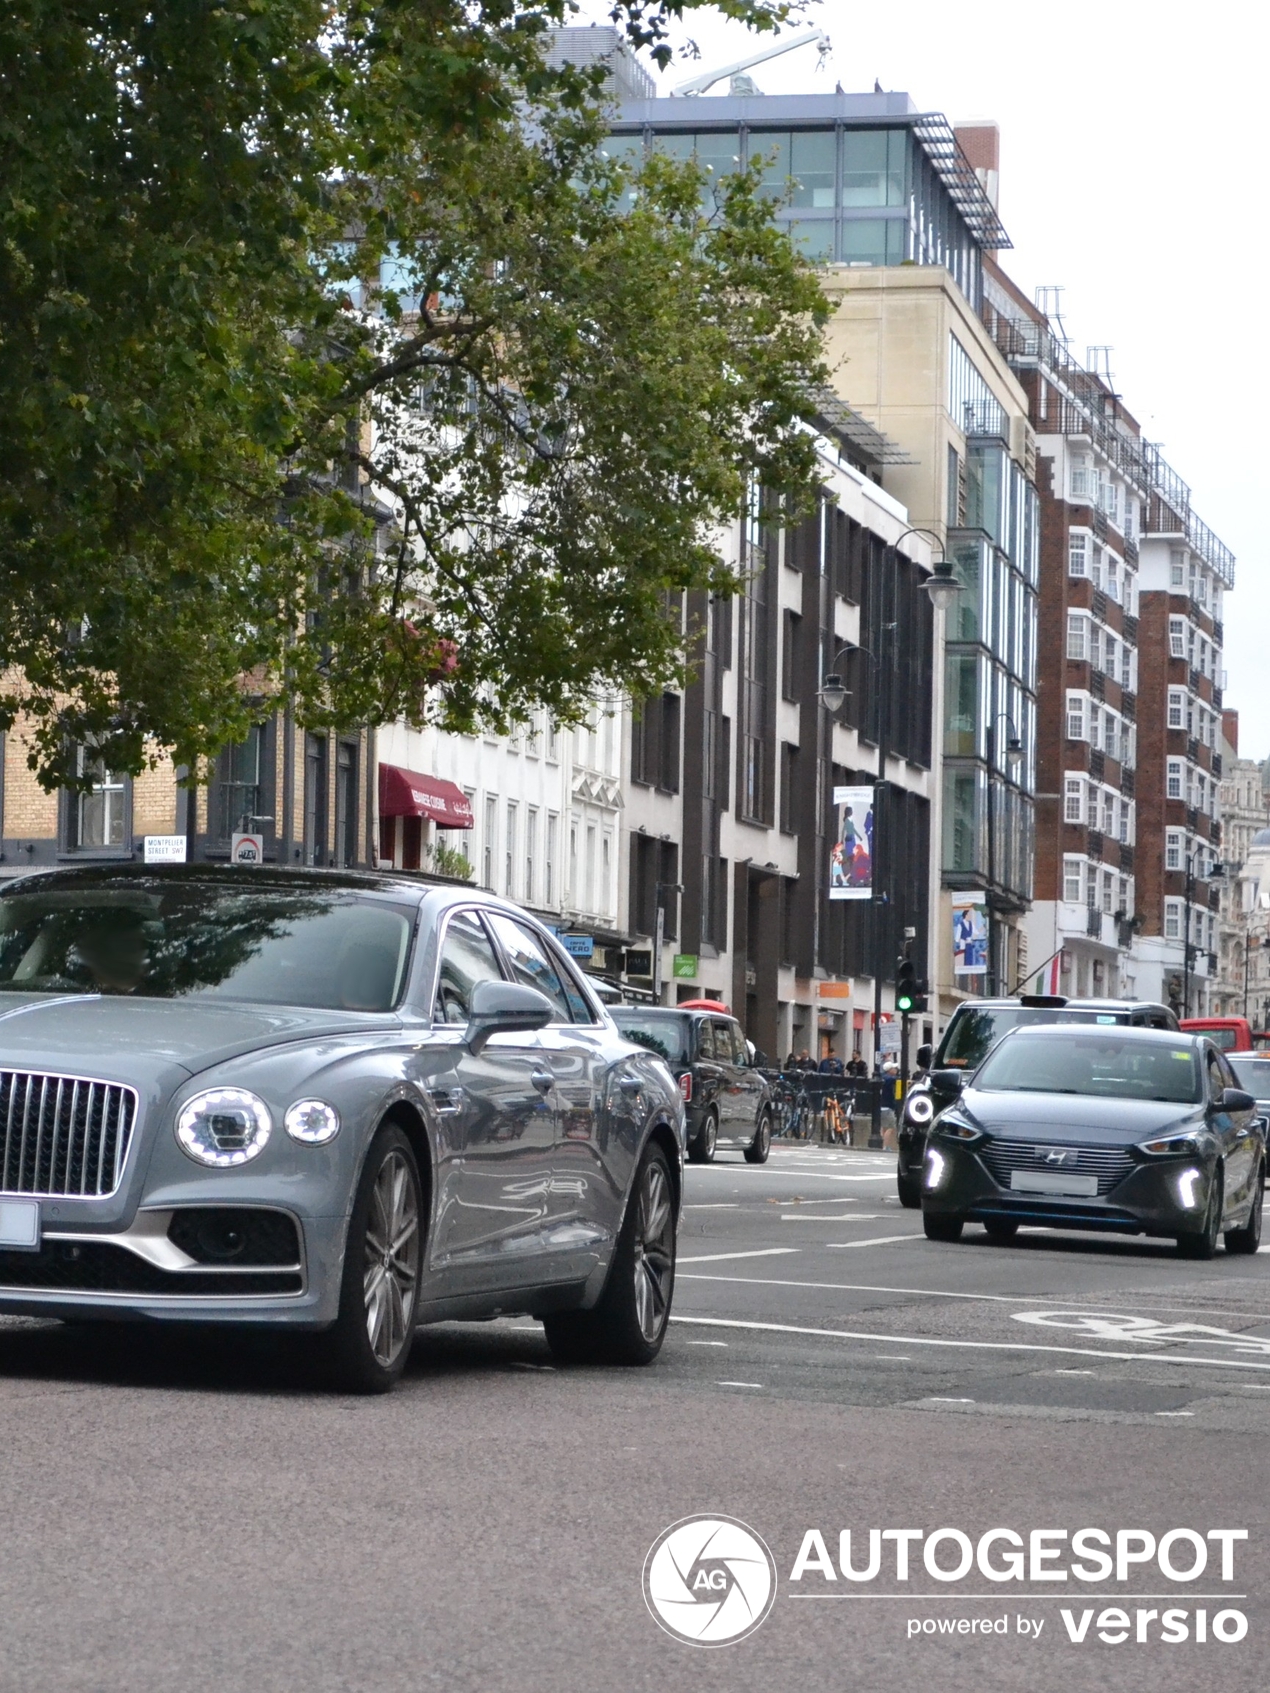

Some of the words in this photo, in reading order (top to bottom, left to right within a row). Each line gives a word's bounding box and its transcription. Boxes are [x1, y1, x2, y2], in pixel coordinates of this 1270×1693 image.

[148, 838, 184, 846] MONTPELIER
[148, 847, 169, 855] STREET
[172, 847, 184, 855] SW7
